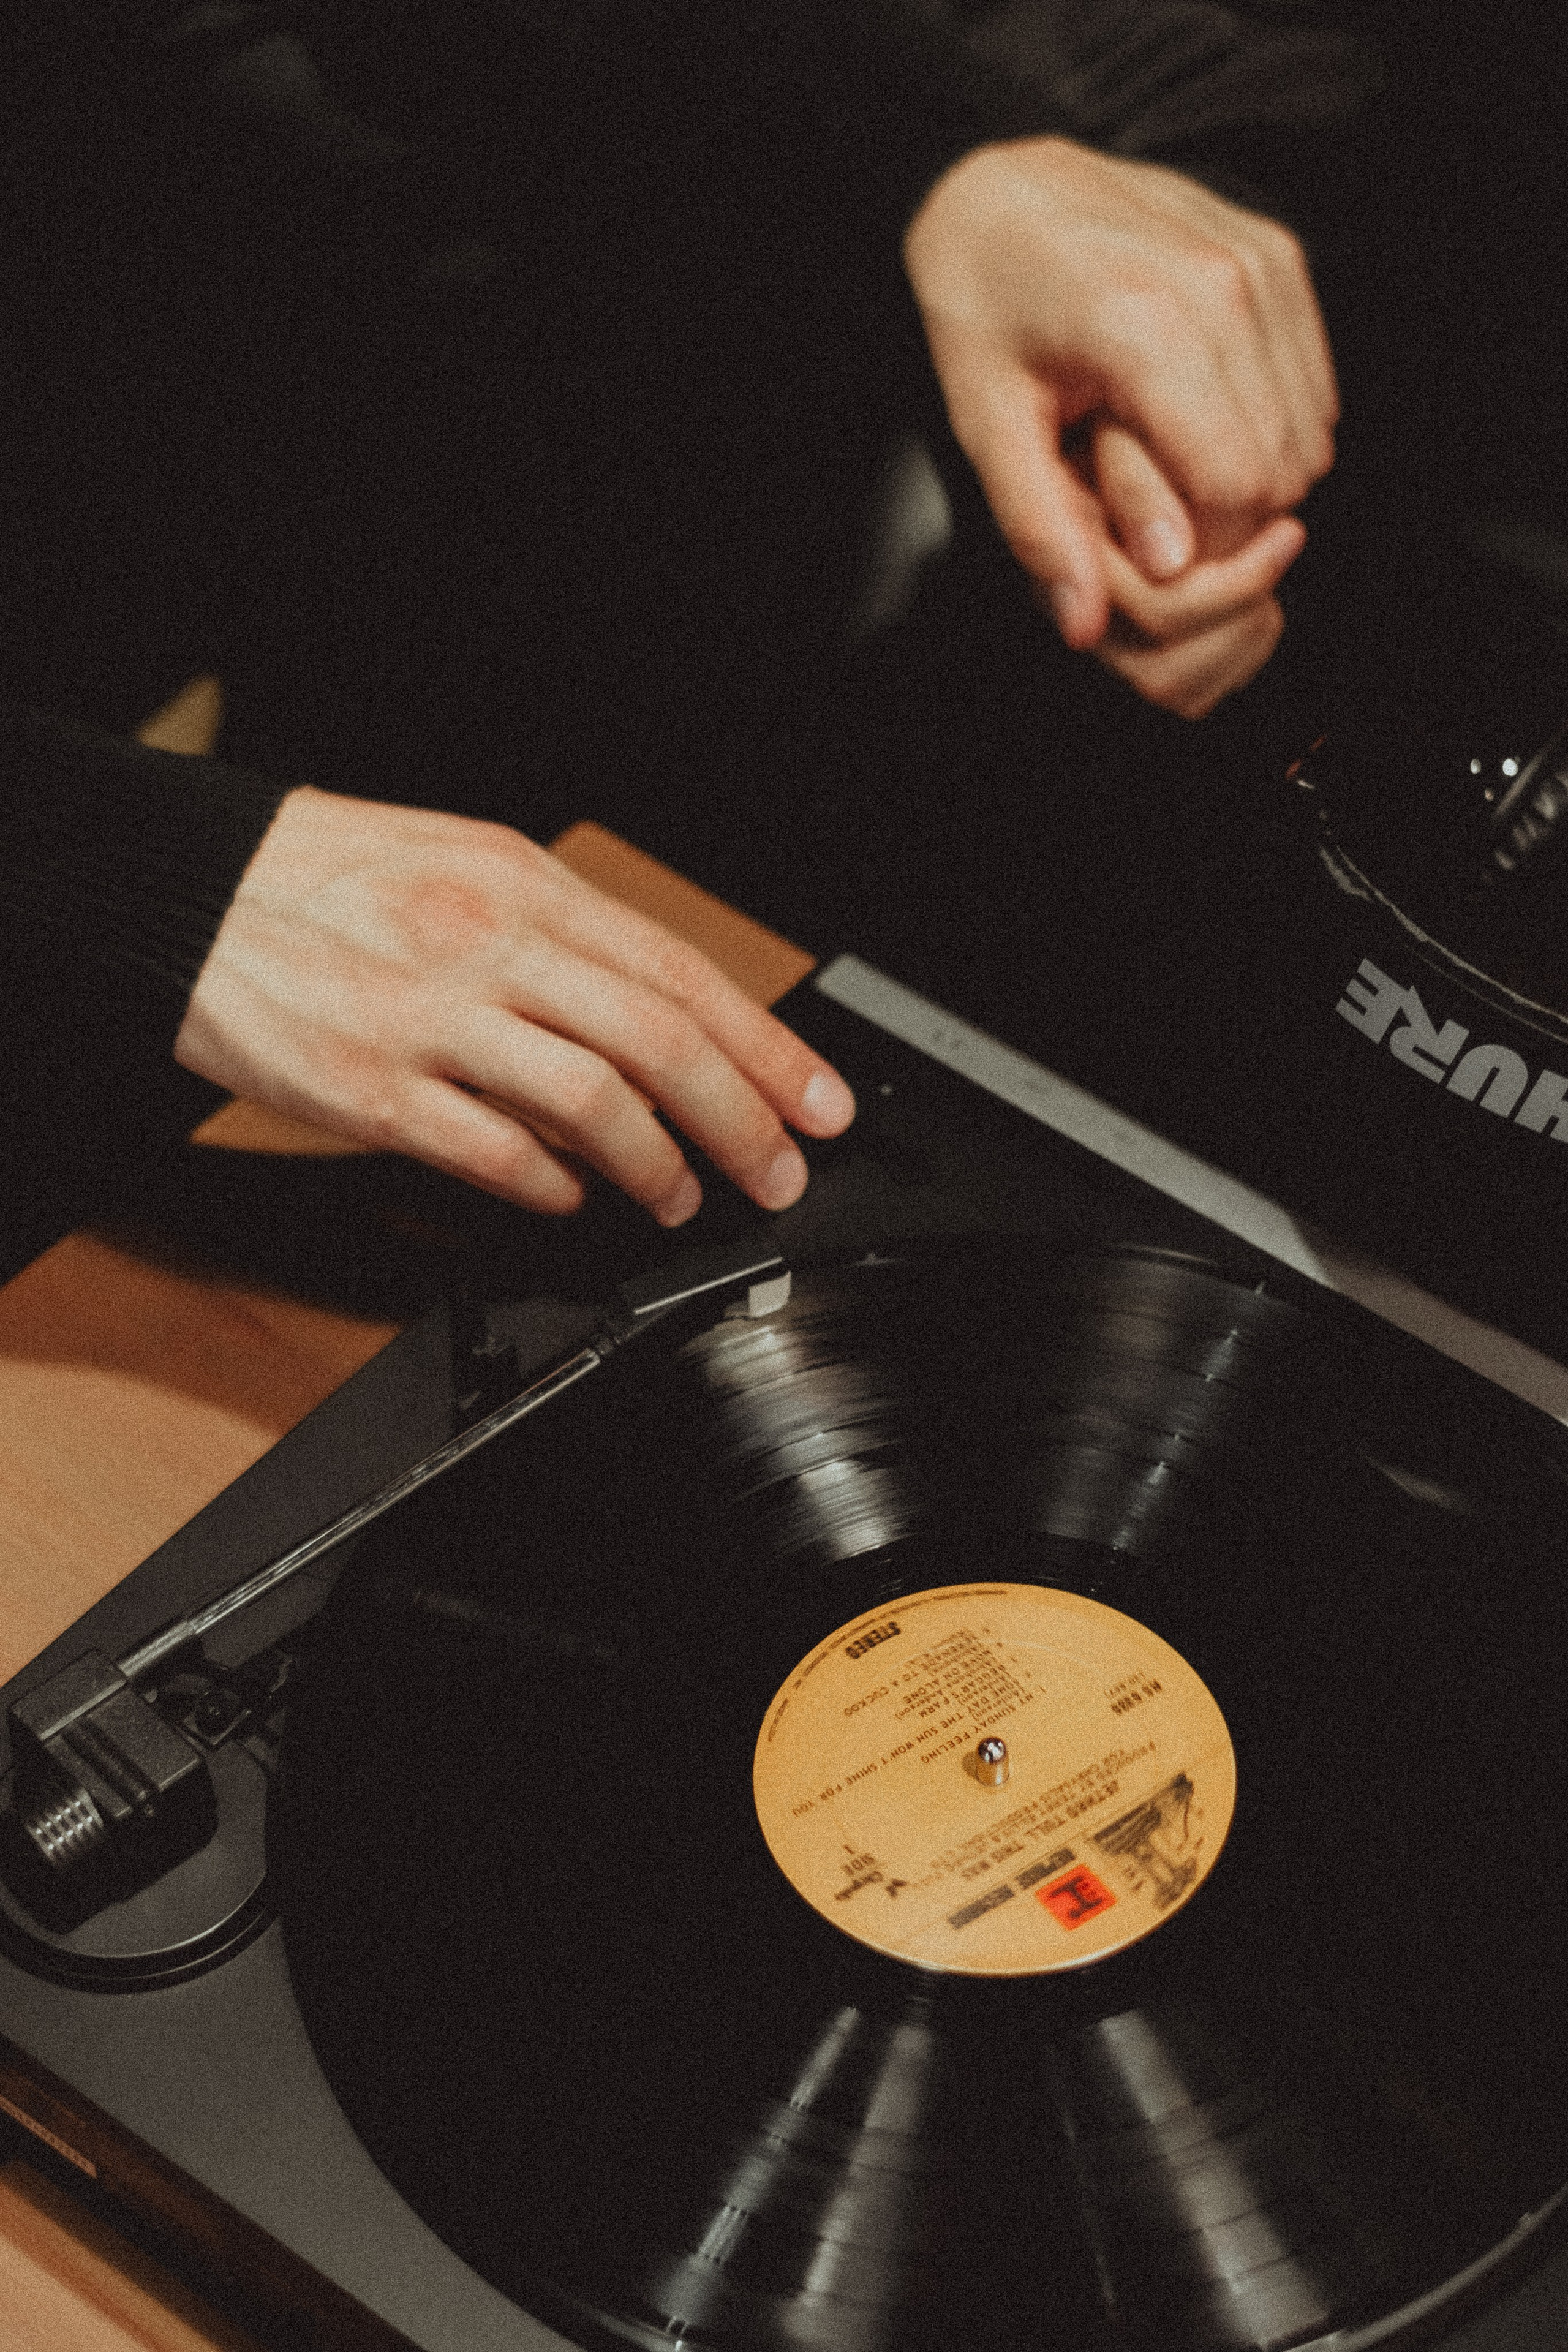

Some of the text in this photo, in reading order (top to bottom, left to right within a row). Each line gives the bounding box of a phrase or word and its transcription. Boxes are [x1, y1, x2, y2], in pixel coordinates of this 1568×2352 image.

[843, 1619, 903, 1661] STEREO
[941, 1667, 959, 1680] ON
[842, 1684, 891, 1717] CUCKOO
[902, 1677, 941, 1704] ALONE
[917, 1696, 949, 1719] FARM
[964, 1695, 989, 1714] DAY
[939, 1711, 963, 1728] THE
[971, 1703, 1016, 1733] SUNDAY
[914, 1726, 938, 1743] SUN
[878, 1740, 914, 1765] WON'T
[918, 1730, 970, 1765] FEELING
[843, 1762, 878, 1786] SHINE
[817, 1782, 843, 1801] FOR
[790, 1798, 816, 1818] YOU
